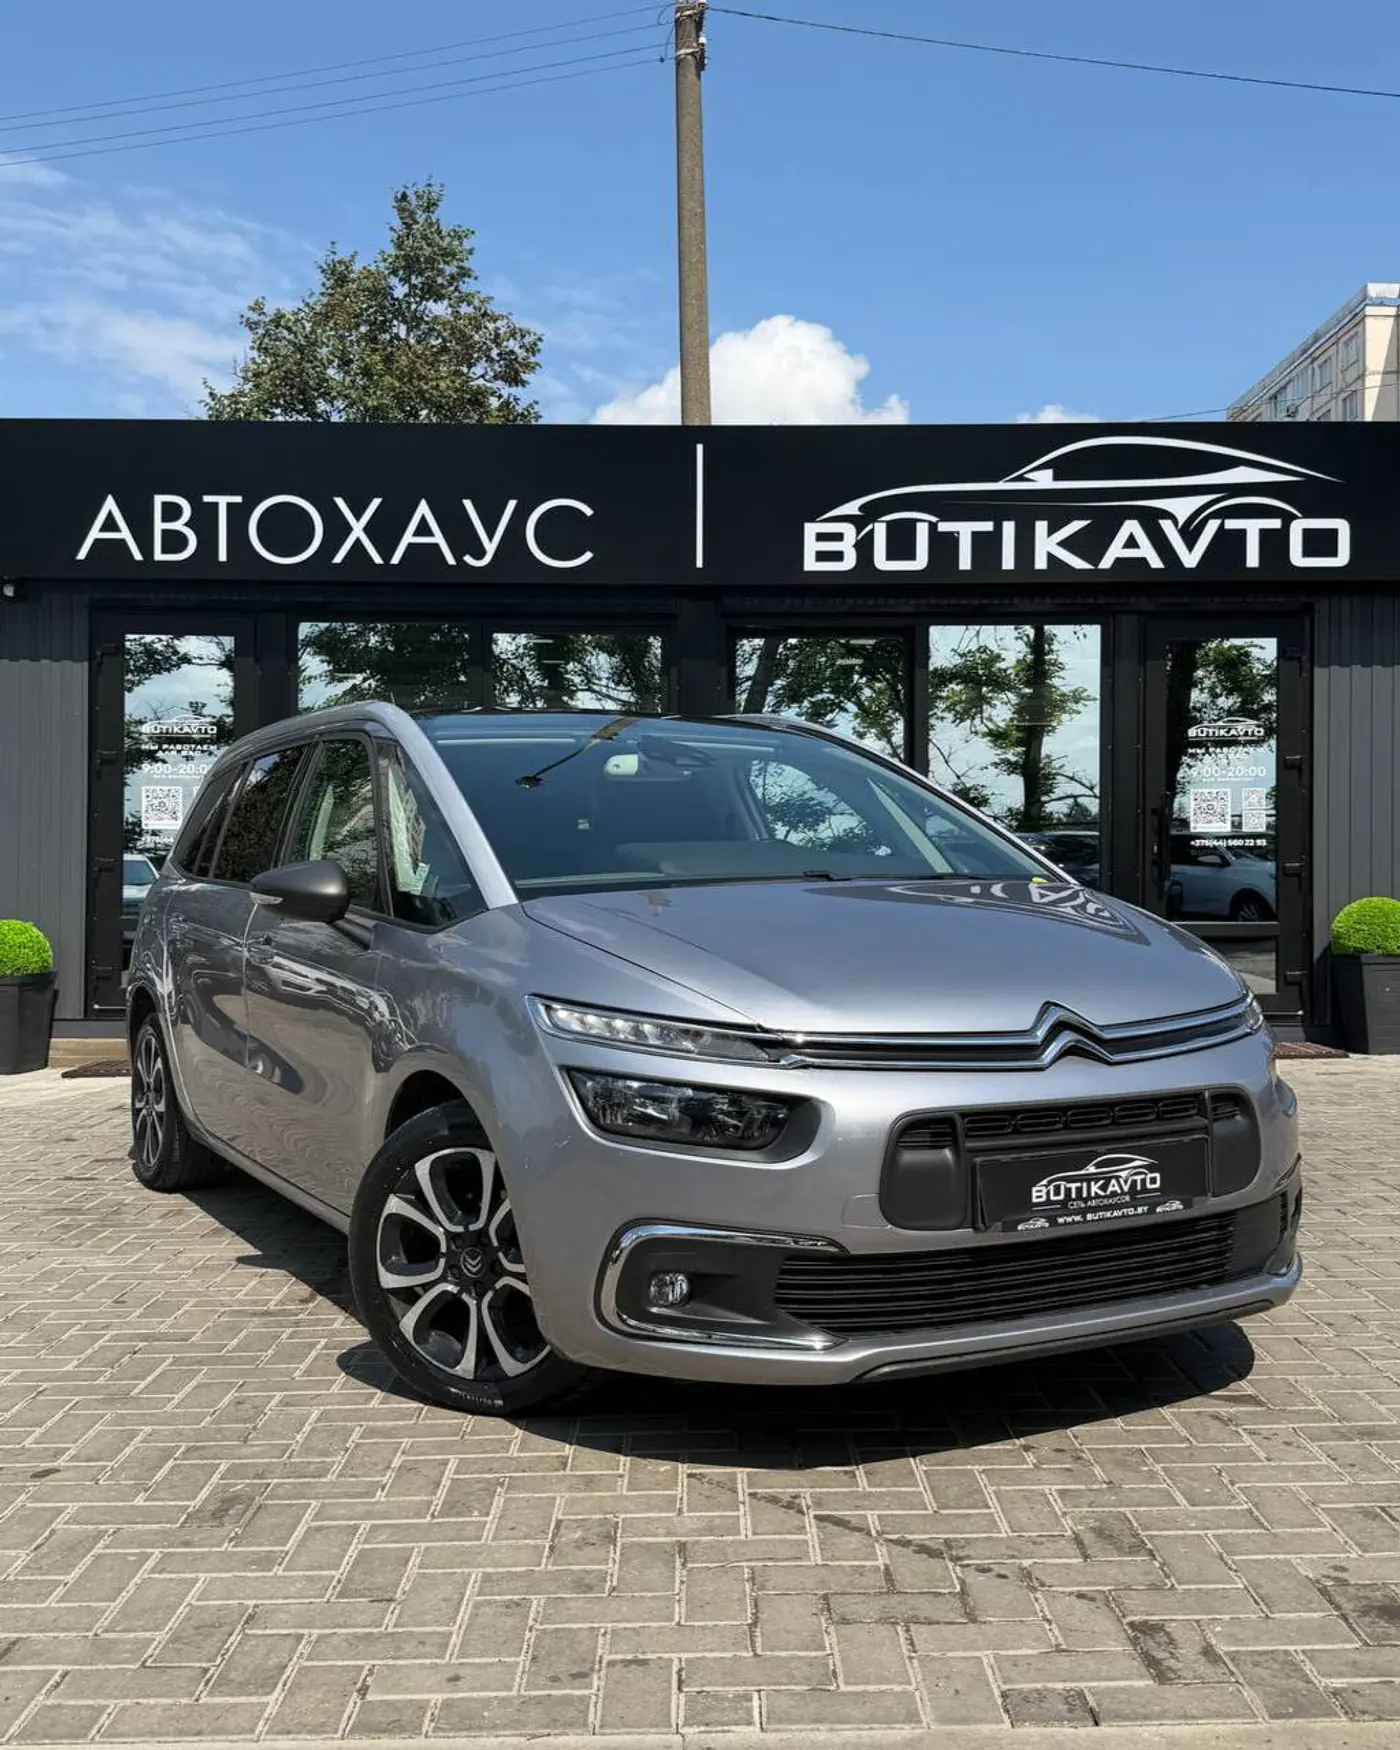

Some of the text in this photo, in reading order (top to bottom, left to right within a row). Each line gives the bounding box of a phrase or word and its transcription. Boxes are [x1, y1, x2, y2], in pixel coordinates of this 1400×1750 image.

[75, 494, 595, 569] АВТОХАУС
[803, 518, 1351, 572] BUTIKAVTO
[1187, 728, 1265, 737] BUTIKAVTO
[141, 763, 212, 774] 9:00-20:0
[1190, 766, 1267, 777] 9:00-20:00
[1031, 1172, 1161, 1203] BUTIKAVTO
